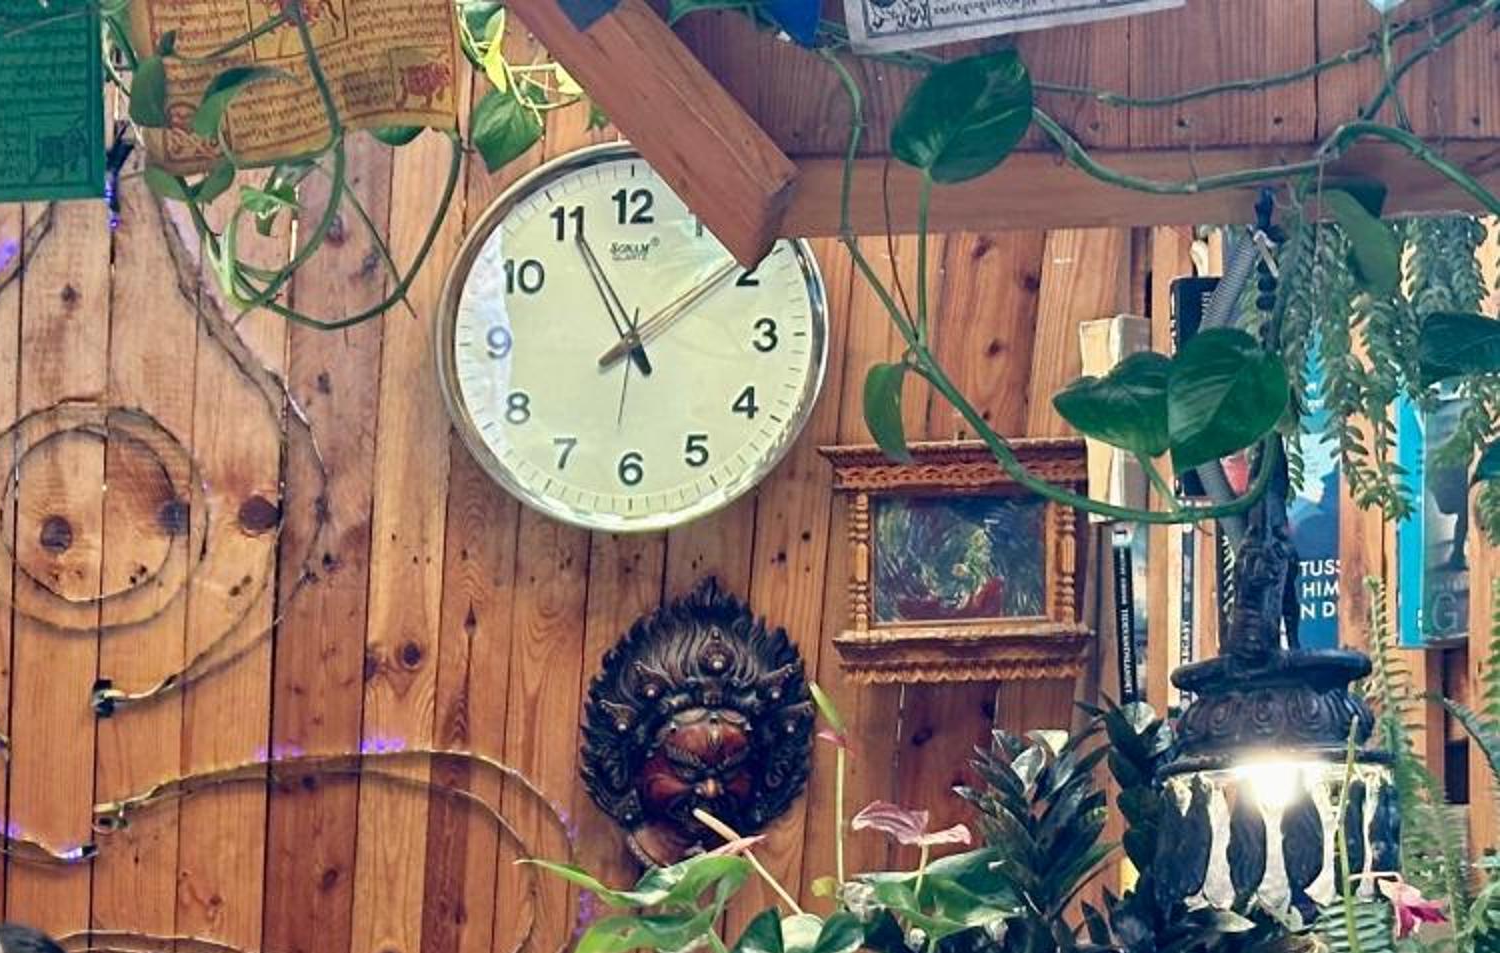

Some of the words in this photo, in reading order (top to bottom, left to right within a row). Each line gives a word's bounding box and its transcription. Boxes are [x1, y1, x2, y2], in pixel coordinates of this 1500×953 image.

[550, 205, 585, 241] 11
[611, 188, 654, 224] 12
[503, 259, 545, 294] 10
[486, 325, 512, 359] 9
[753, 317, 778, 352] 3
[504, 391, 531, 425] 8
[732, 386, 759, 419] 4
[554, 437, 578, 470] 7
[685, 434, 709, 467] 5
[618, 452, 644, 486] 6
